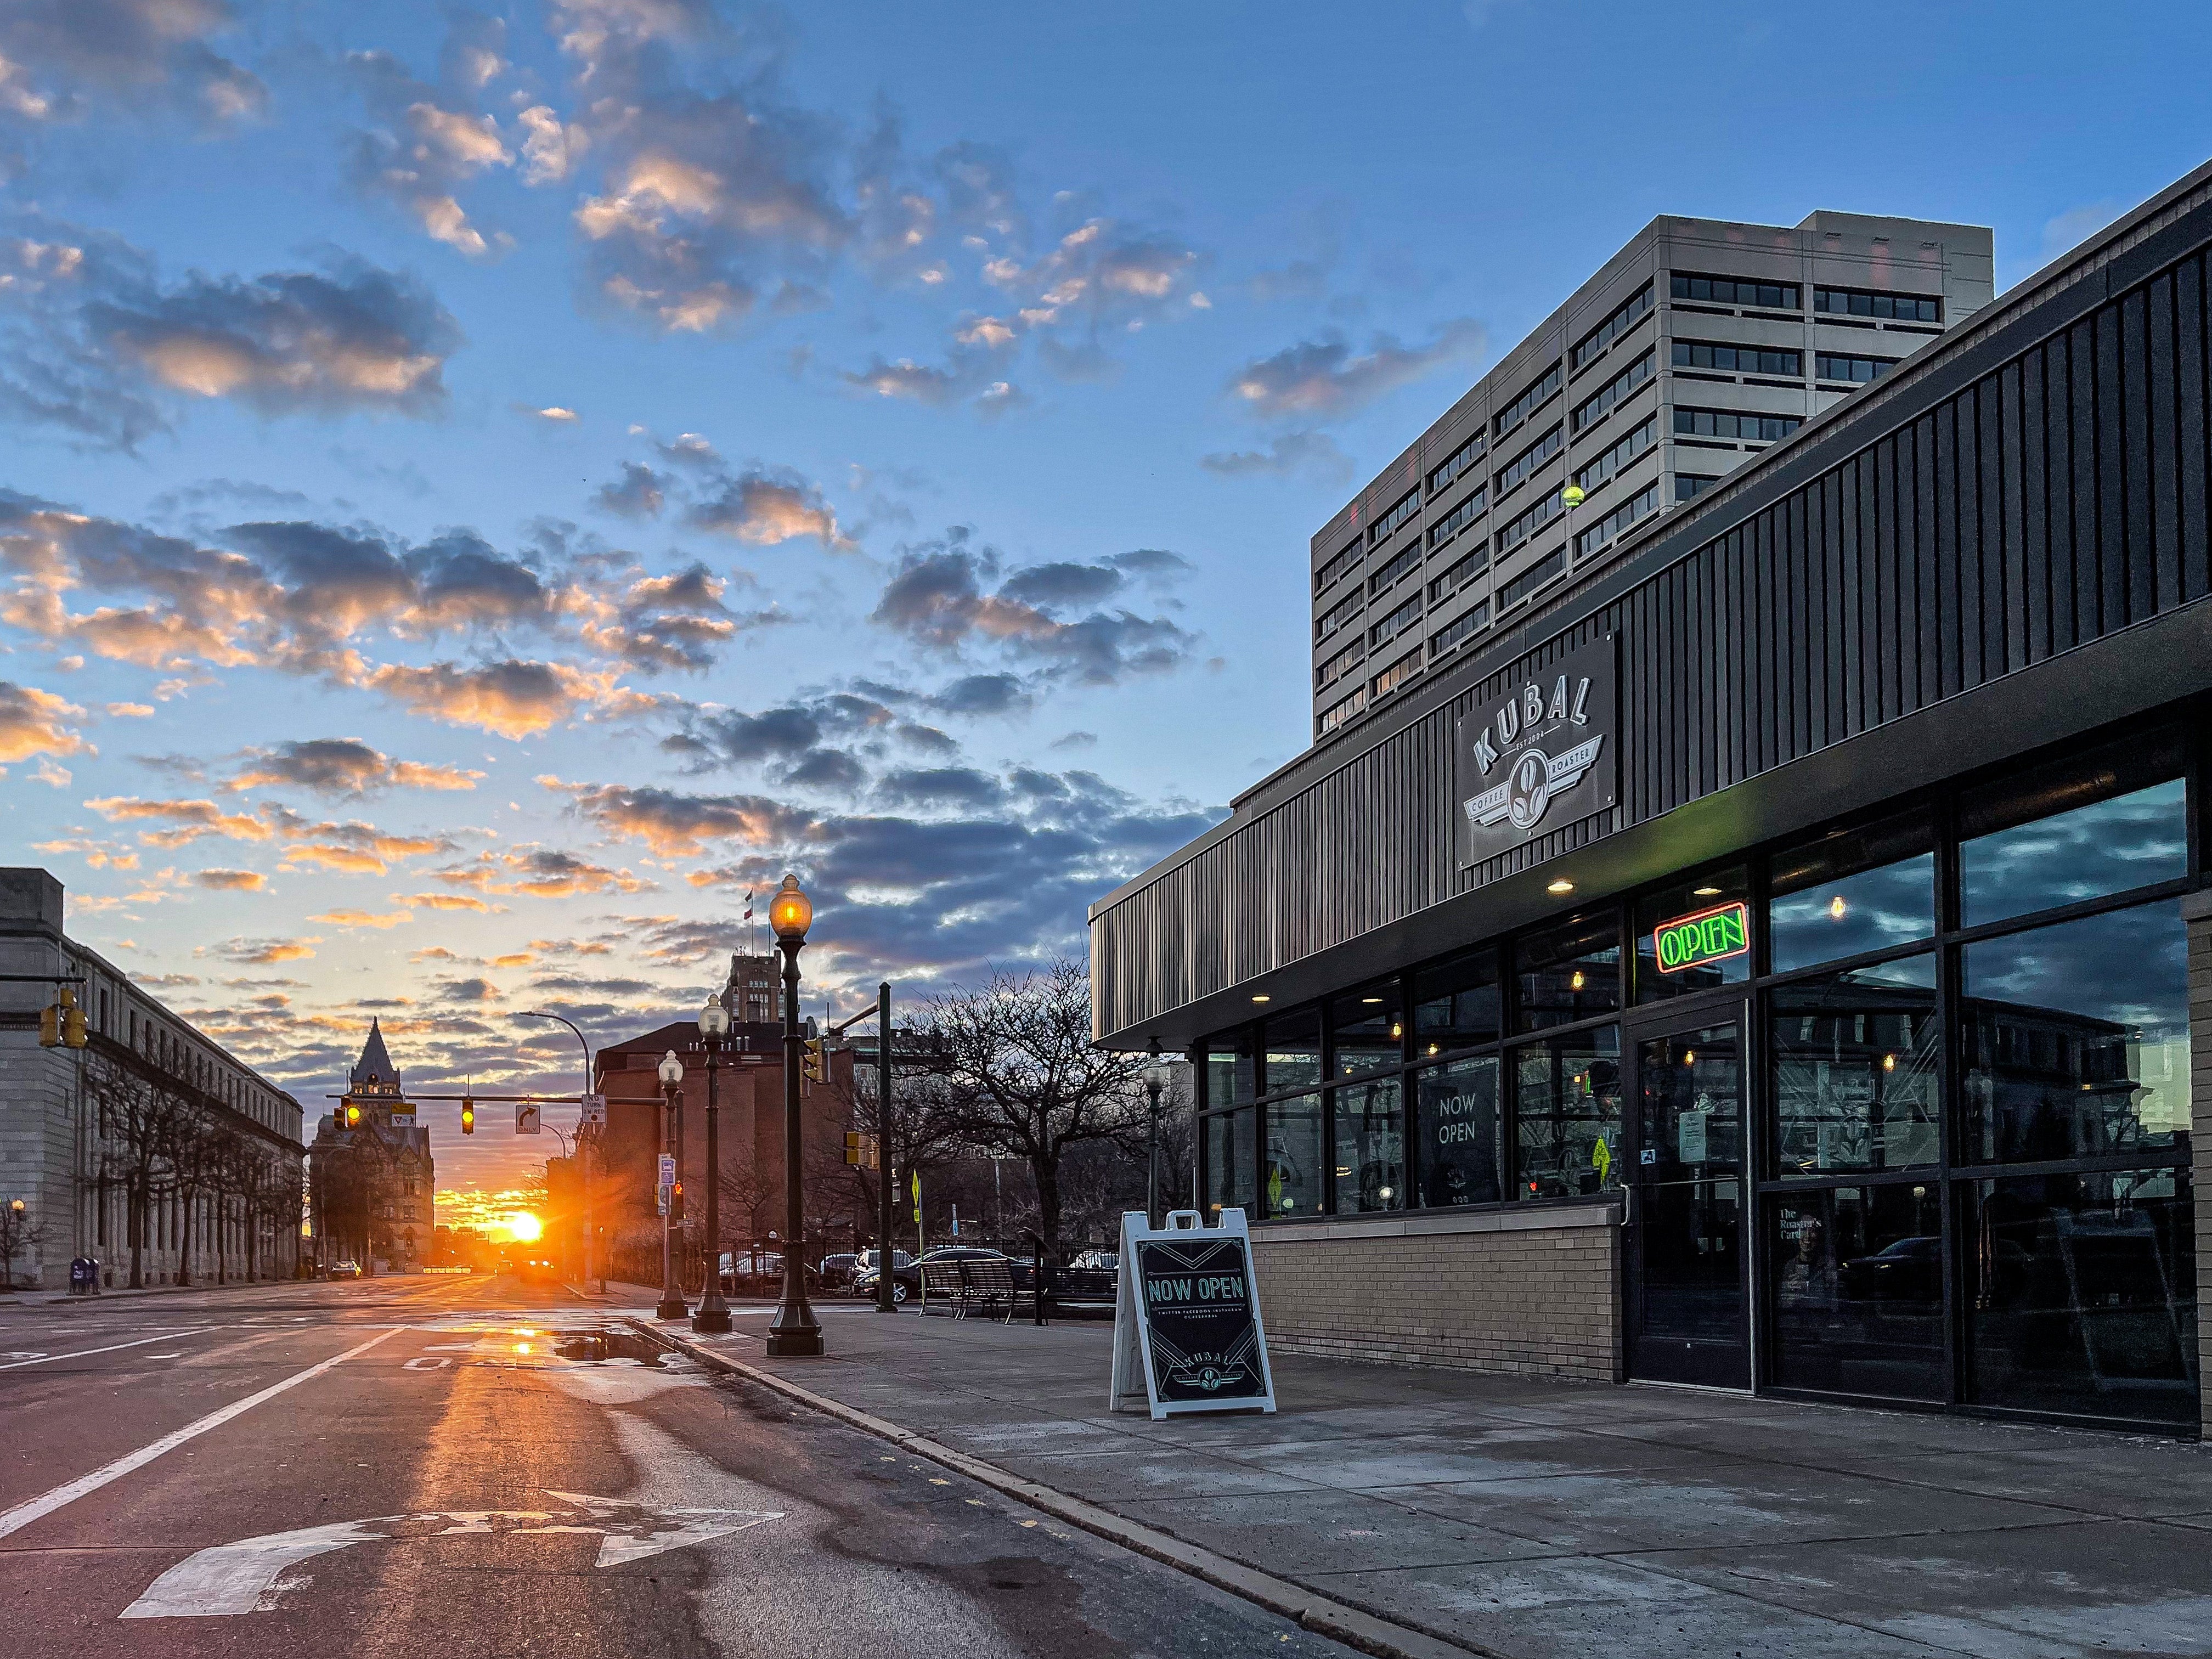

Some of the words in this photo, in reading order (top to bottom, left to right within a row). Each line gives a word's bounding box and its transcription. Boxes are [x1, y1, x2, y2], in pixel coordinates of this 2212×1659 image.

[1473, 674, 1590, 776] KUBAL
[1472, 789, 1503, 812] COFFEE
[1552, 748, 1589, 774] ROASTER
[1660, 910, 1745, 965] OPEN
[1440, 1093, 1476, 1116] NOW
[1439, 1121, 1475, 1144] OPEN
[1780, 1209, 1796, 1218] The
[1780, 1228, 1801, 1239] Card
[1149, 1279, 1192, 1301] NOW
[1199, 1277, 1244, 1299] OPEN
[1185, 1352, 1228, 1367] KUBAL
